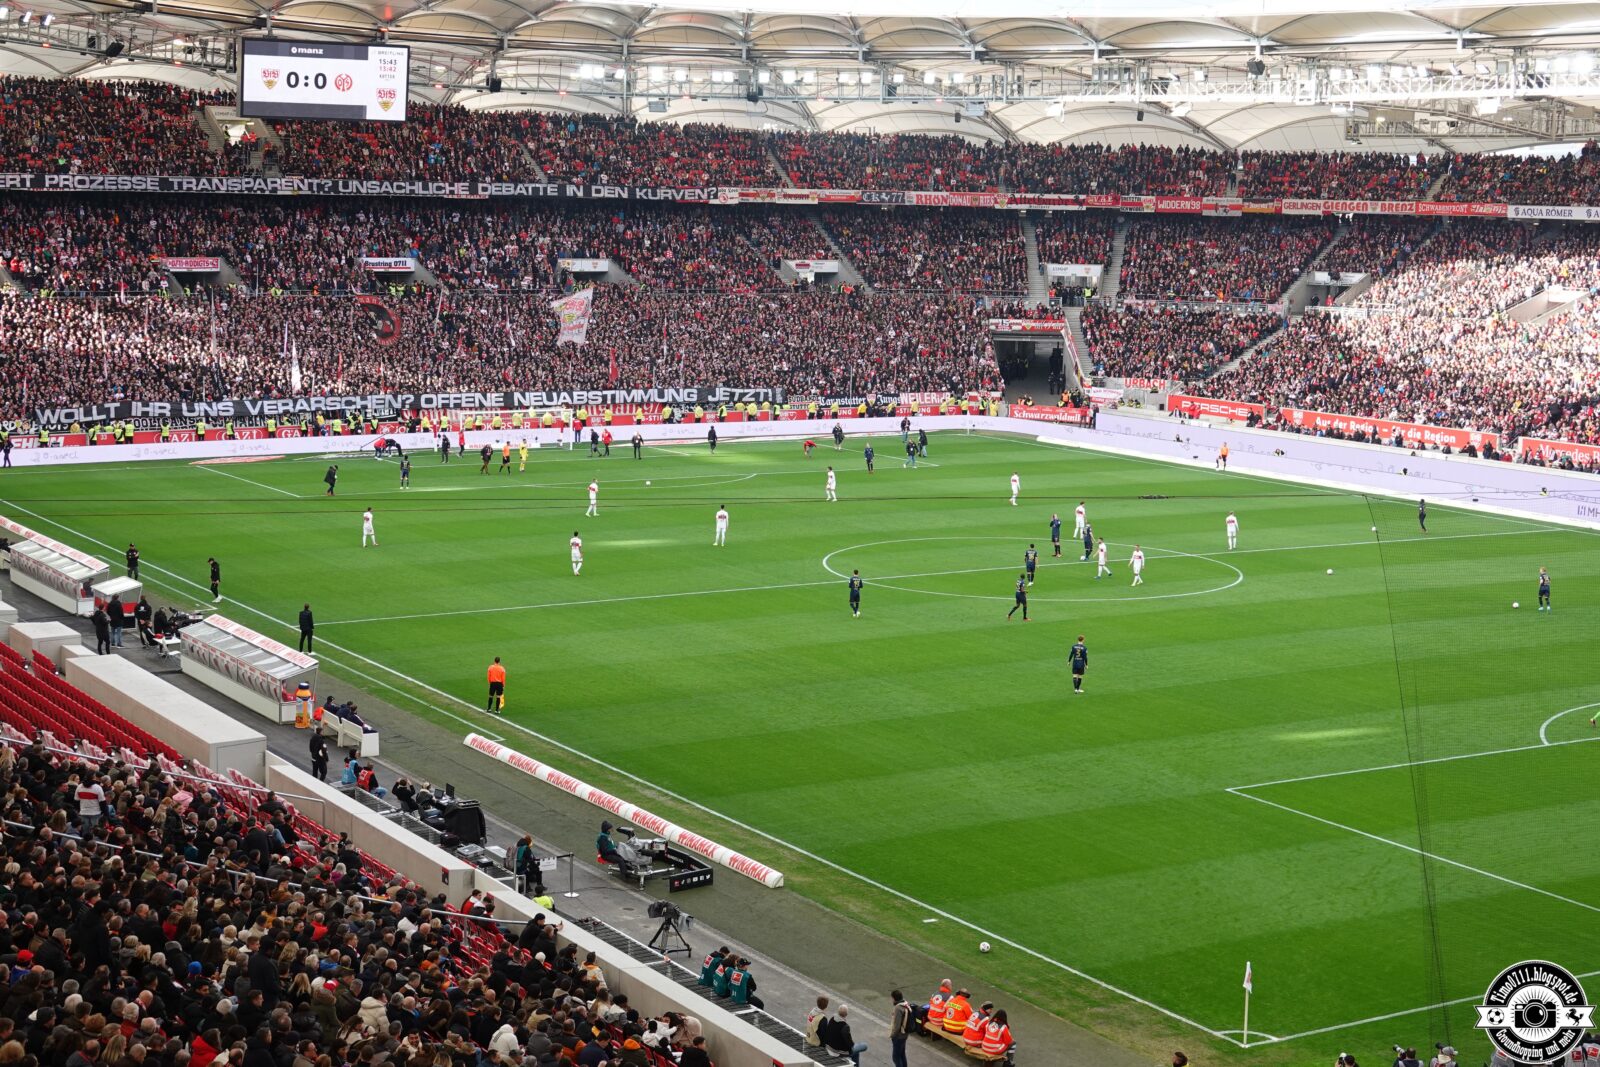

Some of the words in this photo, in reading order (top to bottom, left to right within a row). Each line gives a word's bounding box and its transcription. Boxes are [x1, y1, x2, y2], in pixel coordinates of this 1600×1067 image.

[45, 174, 160, 190] PROZESSE
[168, 177, 333, 192] TRANSPARENT?
[338, 180, 470, 195] UNSACHLICHE
[478, 183, 558, 196] DEBATTE
[566, 184, 584, 197] IN
[592, 185, 628, 199] DEN
[636, 187, 717, 200] KURVEN?
[1283, 201, 1321, 211] GERLINGEN
[1322, 200, 1369, 212] GIENGEN
[1380, 202, 1415, 212] BRENZ
[1521, 209, 1544, 217] AQUA
[1545, 206, 1573, 217] RÖMER
[35, 402, 121, 425] WOLLT
[131, 401, 171, 417] IHR
[181, 401, 235, 417] UNS
[244, 394, 415, 416] VERARSCHEN?
[420, 392, 505, 409] OFFENE
[513, 388, 698, 407] NEUABSTIMMUNG
[1333, 418, 1347, 429] der
[1407, 427, 1422, 439] die
[1424, 430, 1456, 444] Region
[469, 736, 502, 758] WINAMAX
[507, 752, 541, 775] WINAMAX
[546, 771, 581, 794] WINAMAX
[587, 789, 623, 814] WINAMAX
[631, 809, 670, 836] WINAMAX
[677, 830, 720, 859] WINAMAX
[728, 853, 773, 883] WINAMAX
